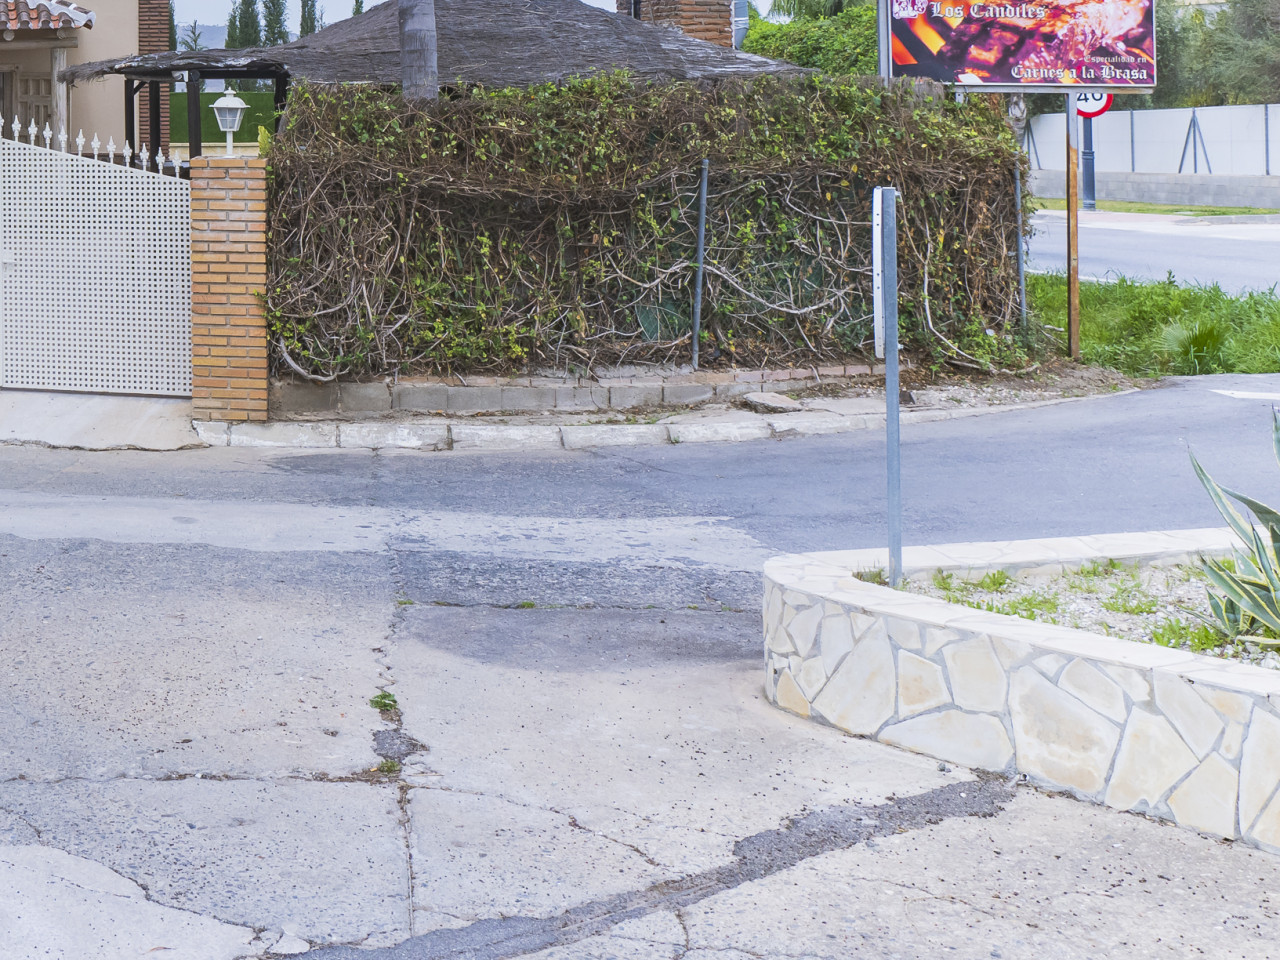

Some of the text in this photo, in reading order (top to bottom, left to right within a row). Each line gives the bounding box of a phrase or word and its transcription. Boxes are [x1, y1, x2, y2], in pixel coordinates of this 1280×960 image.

[929, 2, 1046, 19] Los Candiles
[1083, 55, 1135, 63] Especialidad
[1011, 65, 1148, 79] Carnes a la Brasa
